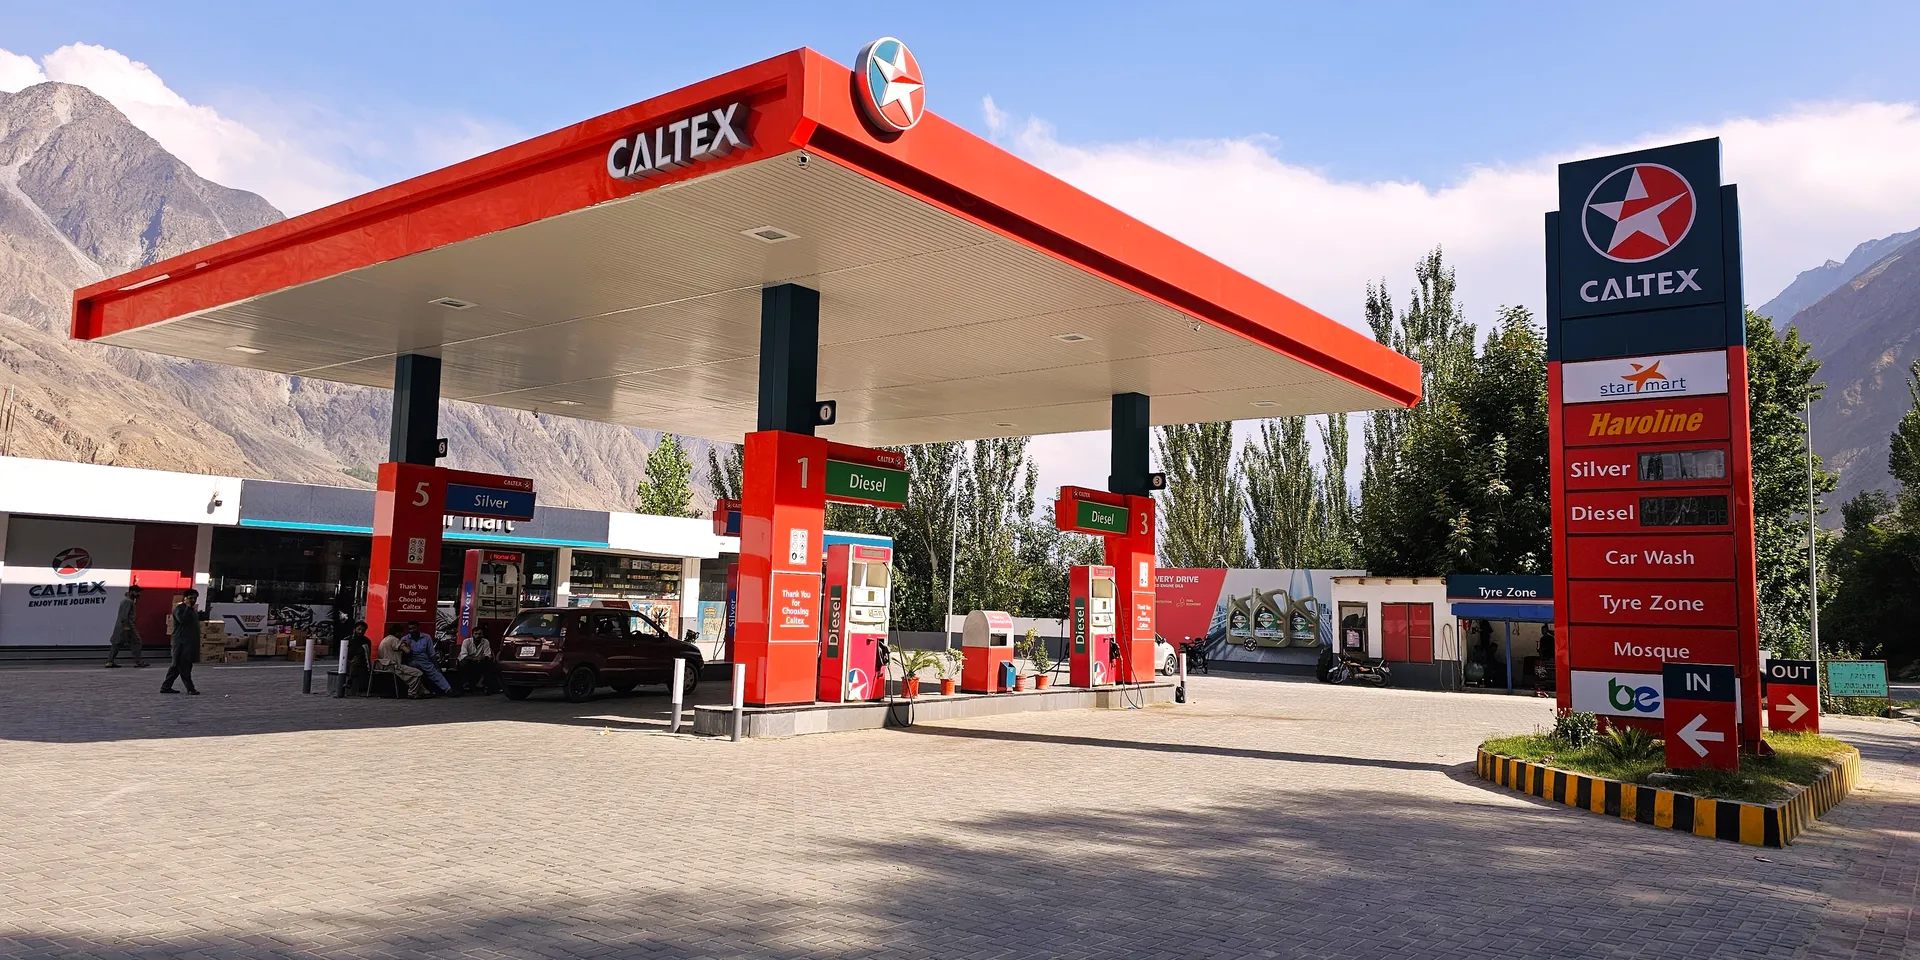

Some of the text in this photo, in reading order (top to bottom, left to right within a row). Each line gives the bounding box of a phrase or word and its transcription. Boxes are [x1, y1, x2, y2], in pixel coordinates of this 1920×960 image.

[606, 102, 741, 180] CALTEX
[1580, 268, 1702, 303] CALTEX
[1600, 377, 1687, 395] star mart
[1588, 409, 1704, 437] Havoline
[876, 455, 895, 464] CALTEX
[797, 457, 809, 488] 1
[1571, 461, 1631, 478] Silver
[849, 473, 887, 492] Diesel
[412, 481, 430, 507] 5
[474, 494, 509, 509] Silver
[1091, 510, 1115, 525] Diesel
[1572, 505, 1634, 521] Diesel
[1140, 512, 1149, 535] 3
[1605, 550, 1695, 565] Car Wash
[1155, 575, 1175, 583] VERY
[29, 581, 106, 598] CALTEX
[781, 589, 811, 598] Thank You
[1479, 587, 1537, 599] Tyre Zone
[68, 597, 107, 606] JOURNEY
[398, 596, 427, 604] Choosing
[791, 599, 801, 607] for
[1599, 594, 1705, 614] Tyre Zone
[462, 592, 471, 626] Silver
[728, 598, 736, 627] Silver
[781, 607, 809, 616] Choosing
[785, 617, 805, 625] Caltex
[828, 597, 841, 646] Diesel
[1075, 606, 1085, 645] Diesel
[1614, 641, 1690, 662] Mosque
[1771, 665, 1811, 680] OUT
[1685, 672, 1711, 692] IN
[1608, 677, 1661, 713] be
